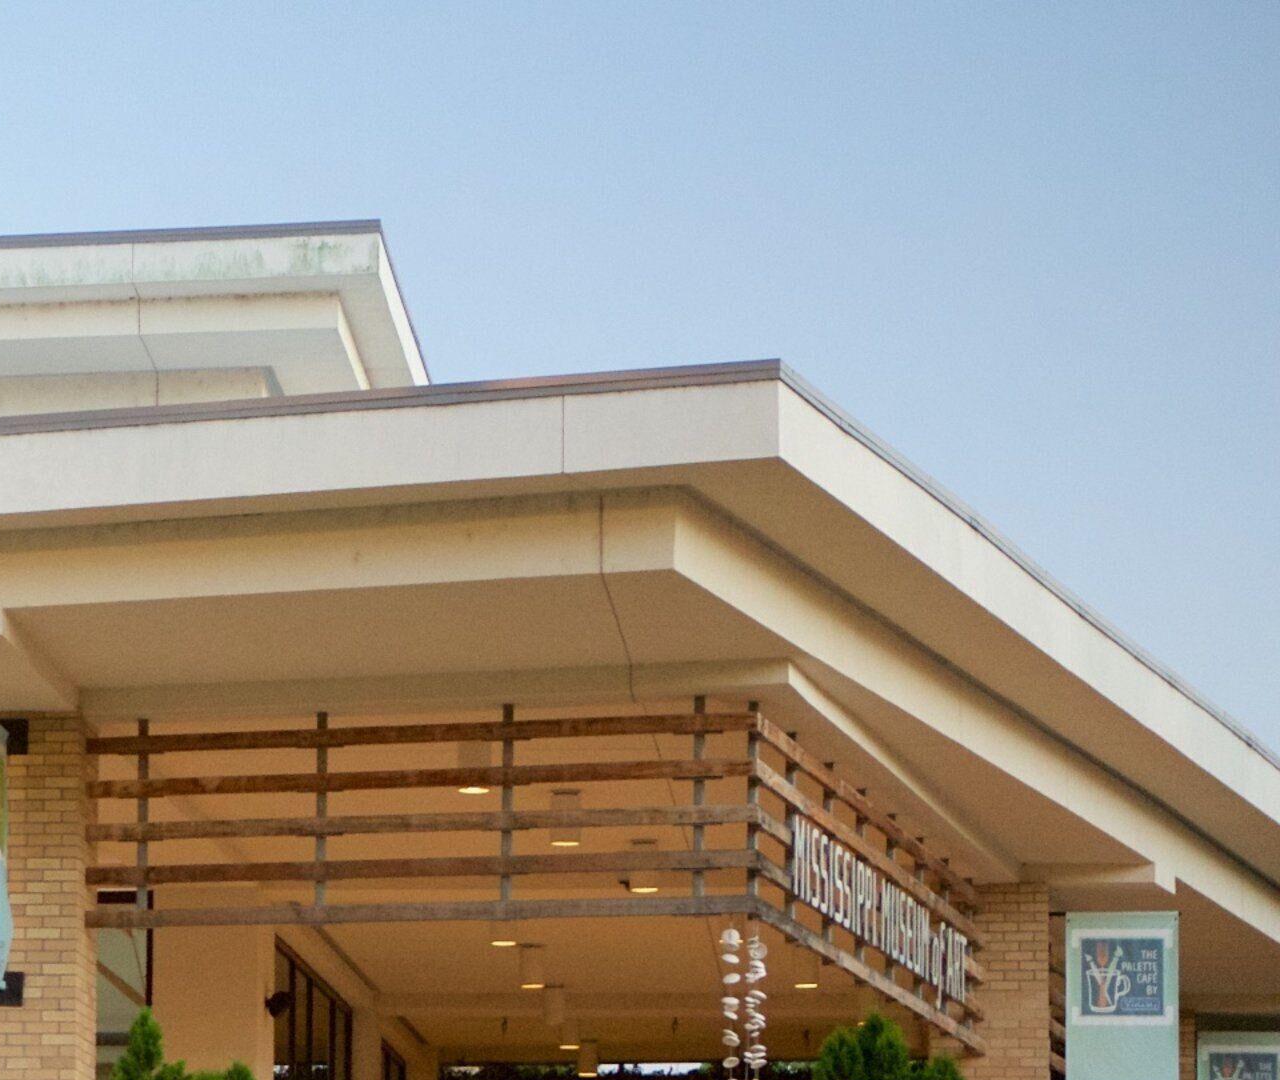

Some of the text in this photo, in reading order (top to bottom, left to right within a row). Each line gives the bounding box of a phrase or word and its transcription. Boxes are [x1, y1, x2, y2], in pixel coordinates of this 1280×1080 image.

[793, 814, 968, 1010] MISSISSIPPI MUSEUM of ART
[1141, 949, 1158, 960] THE
[1121, 961, 1158, 972] PALETTE
[1146, 985, 1158, 996] BY
